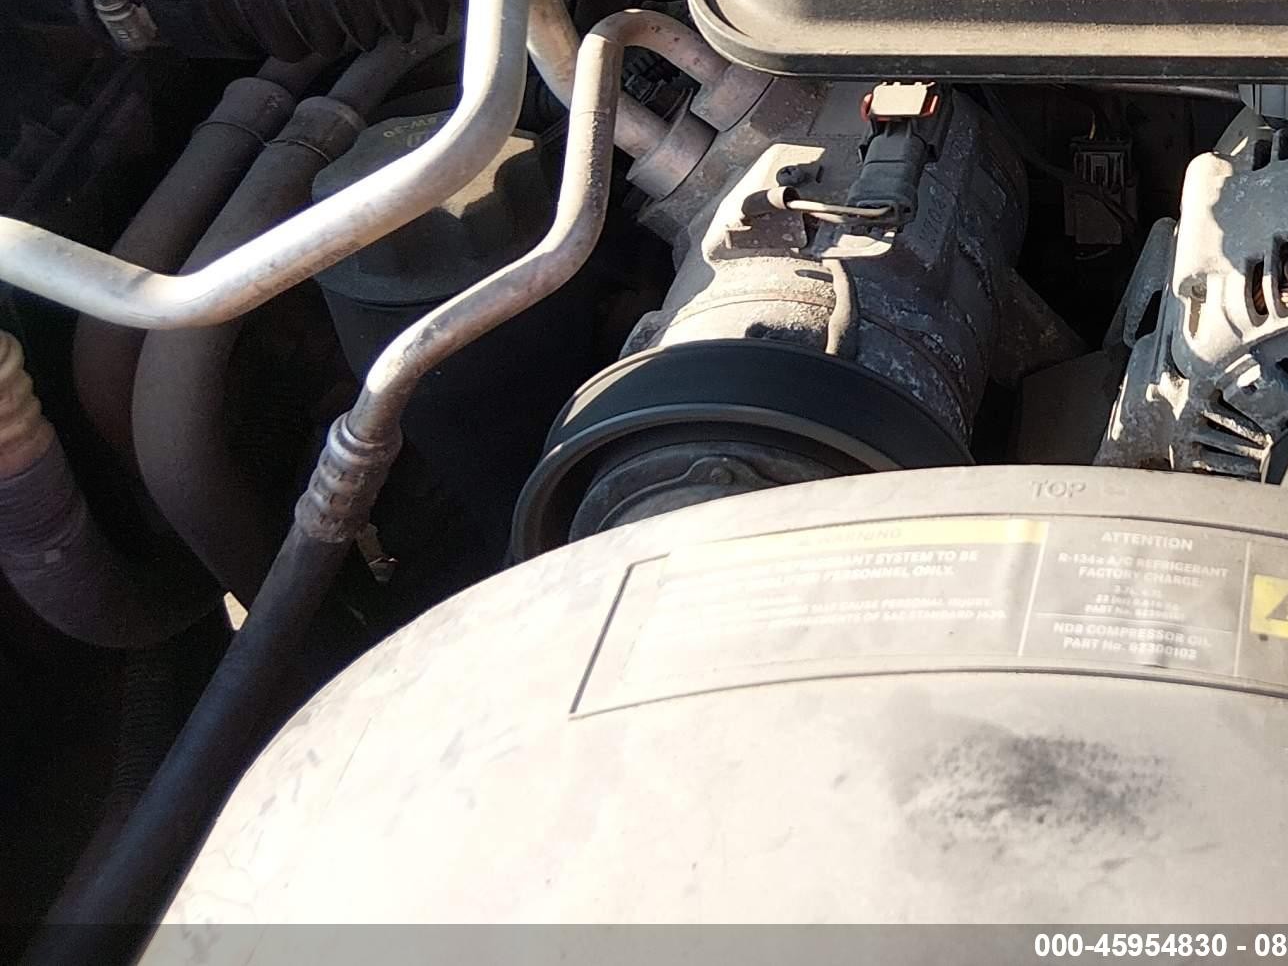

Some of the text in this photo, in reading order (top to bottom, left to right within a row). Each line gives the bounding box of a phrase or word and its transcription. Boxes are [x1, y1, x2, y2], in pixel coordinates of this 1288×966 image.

[1029, 479, 1087, 500] TOP
[1100, 531, 1194, 552] ATTENTION
[874, 550, 933, 565] SYSTEM
[937, 549, 957, 562] TO
[959, 549, 979, 562] BE
[1078, 565, 1140, 581] FACTORY
[1085, 622, 1185, 644] COMPRESSOR
[1063, 636, 1100, 650] PART
